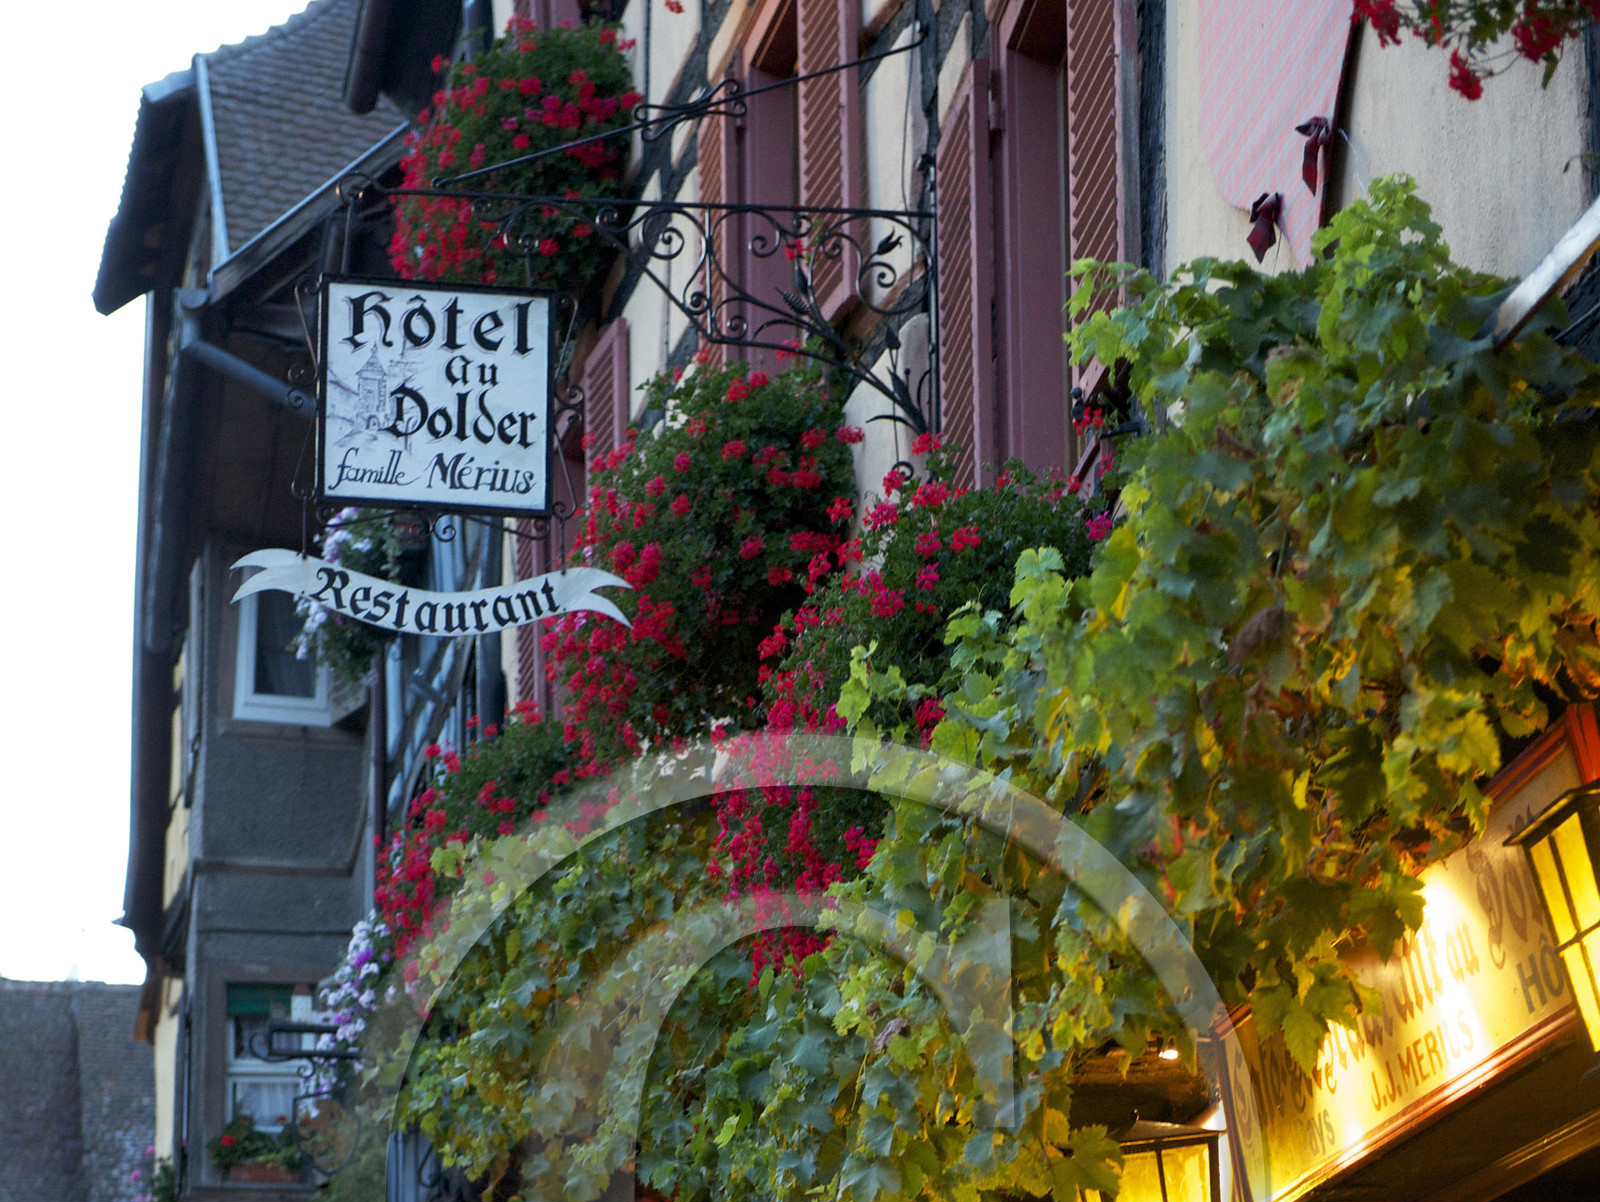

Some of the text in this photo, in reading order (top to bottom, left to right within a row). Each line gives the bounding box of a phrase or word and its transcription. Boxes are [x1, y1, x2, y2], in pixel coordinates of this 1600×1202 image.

[341, 291, 534, 355] Hôtel
[378, 384, 537, 449] Dolder
[328, 447, 538, 494] famille Mérius
[309, 567, 560, 633] Restaurant
